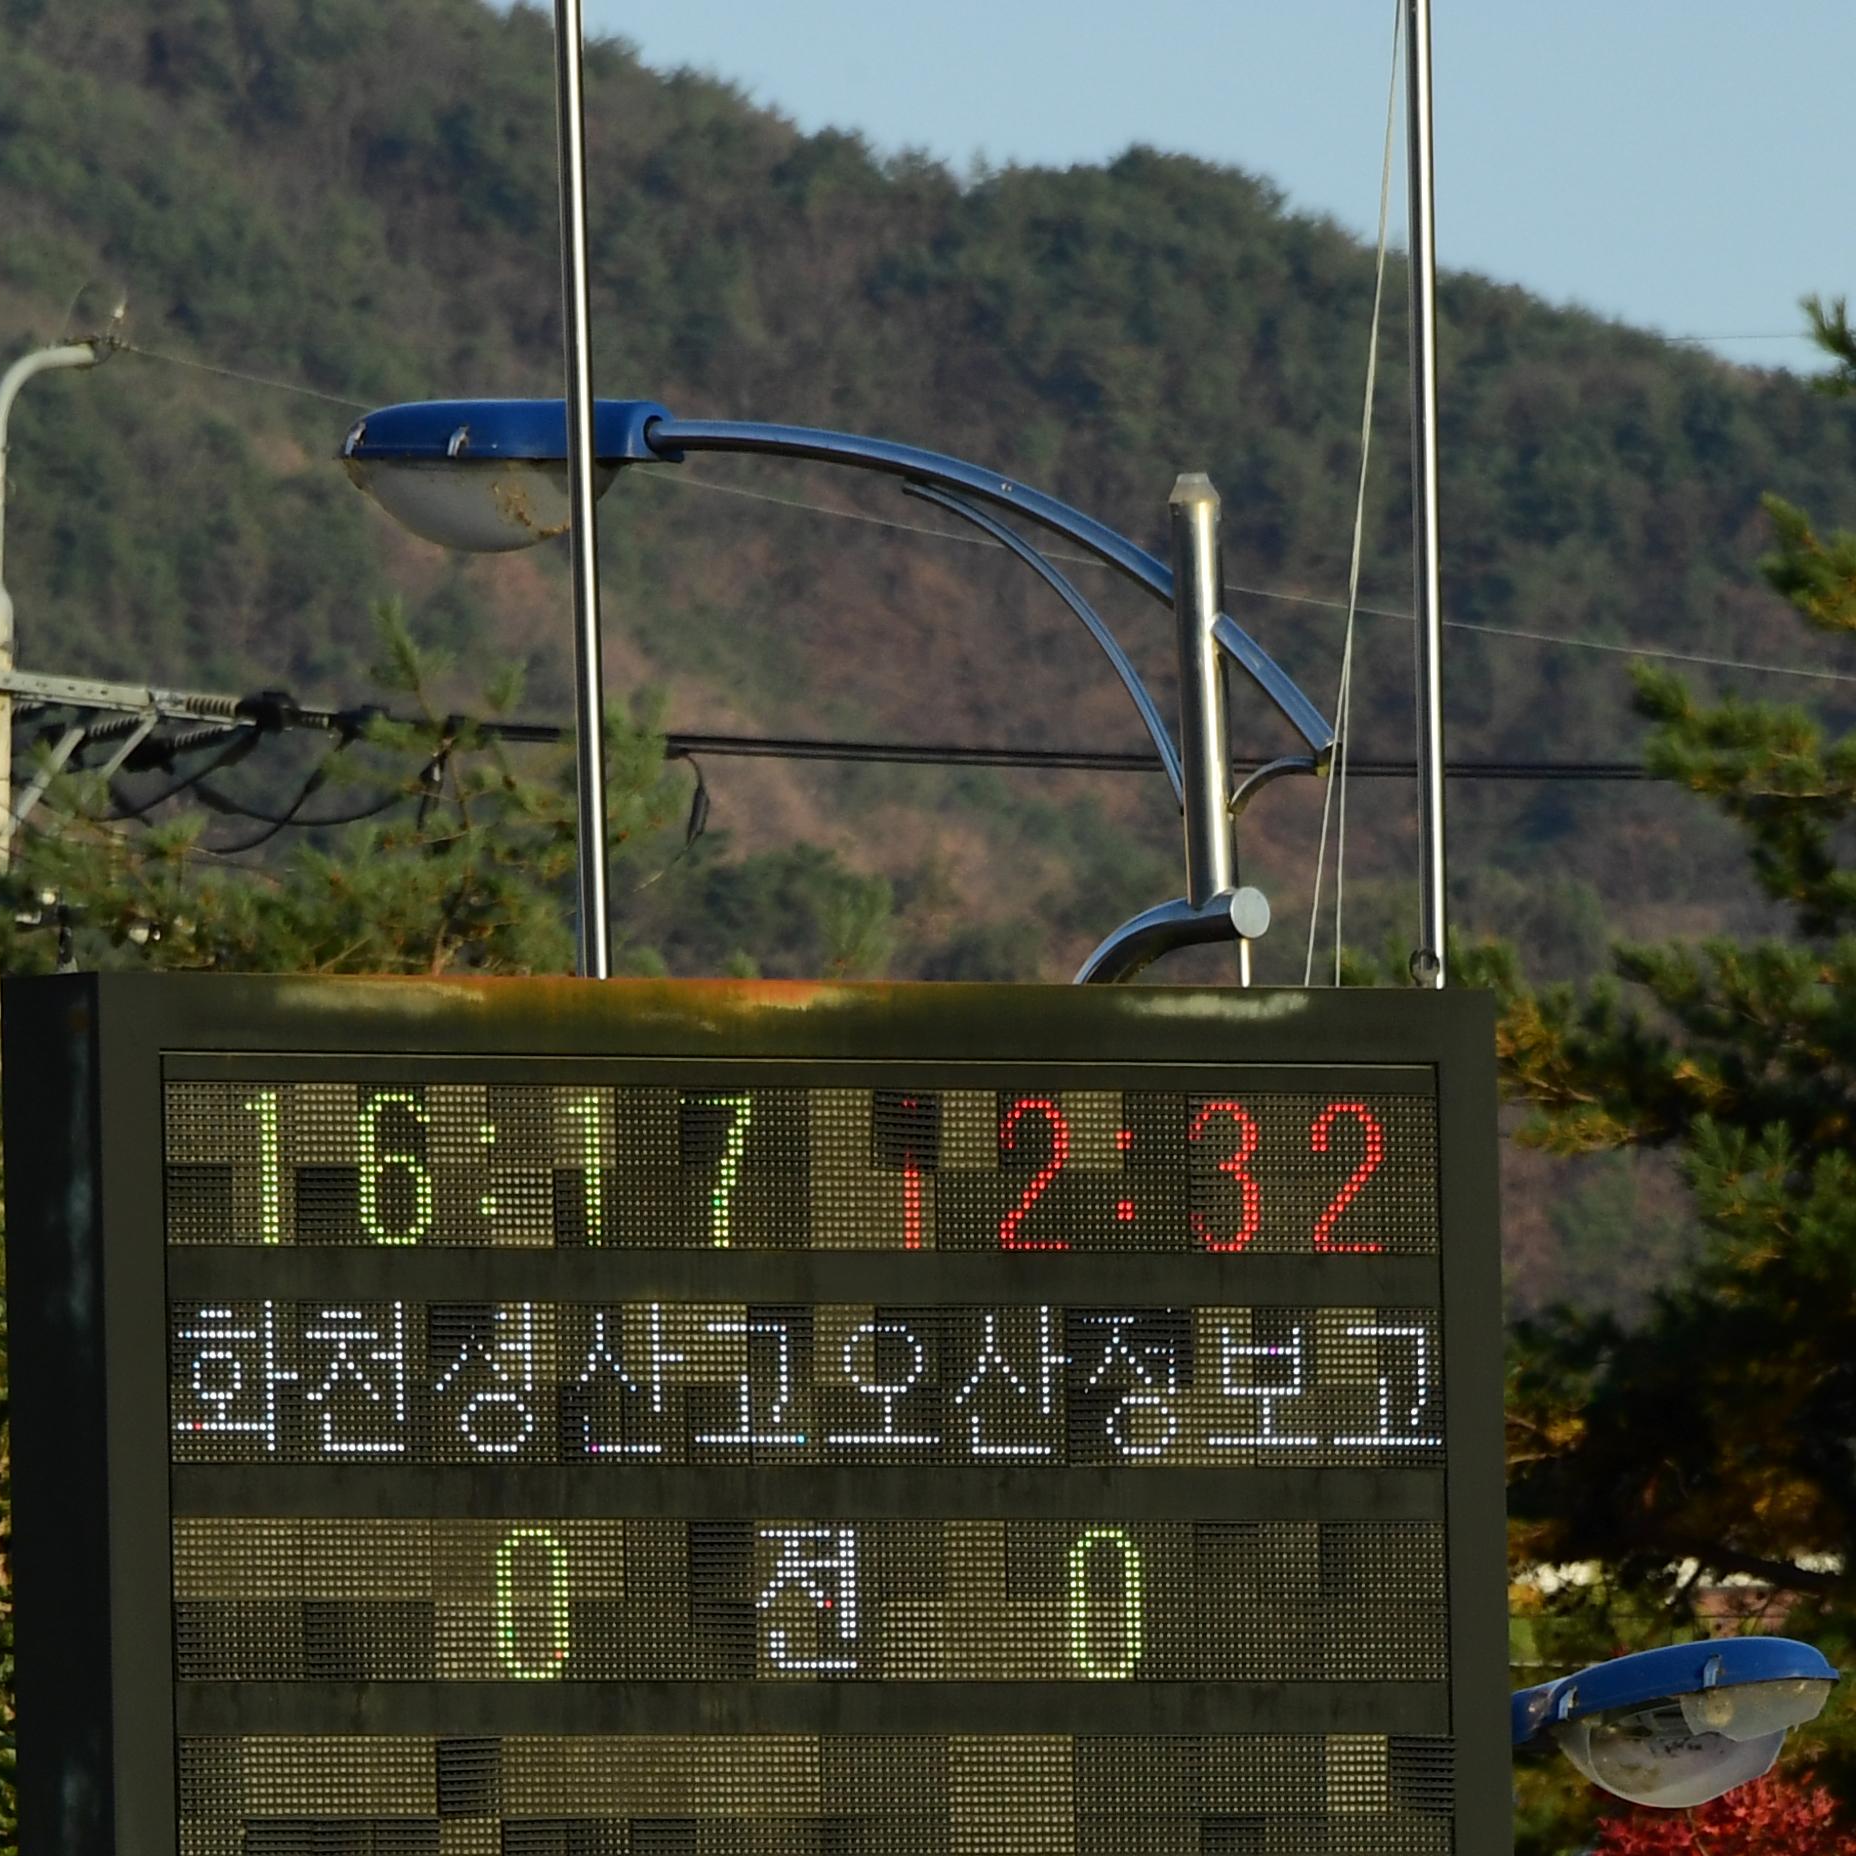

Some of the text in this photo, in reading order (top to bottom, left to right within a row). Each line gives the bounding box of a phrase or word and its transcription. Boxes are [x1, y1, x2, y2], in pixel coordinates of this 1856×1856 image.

[243, 1089, 753, 1248] 16:17
[901, 1097, 1385, 1253] 12:32
[755, 1529, 858, 1670] 전
